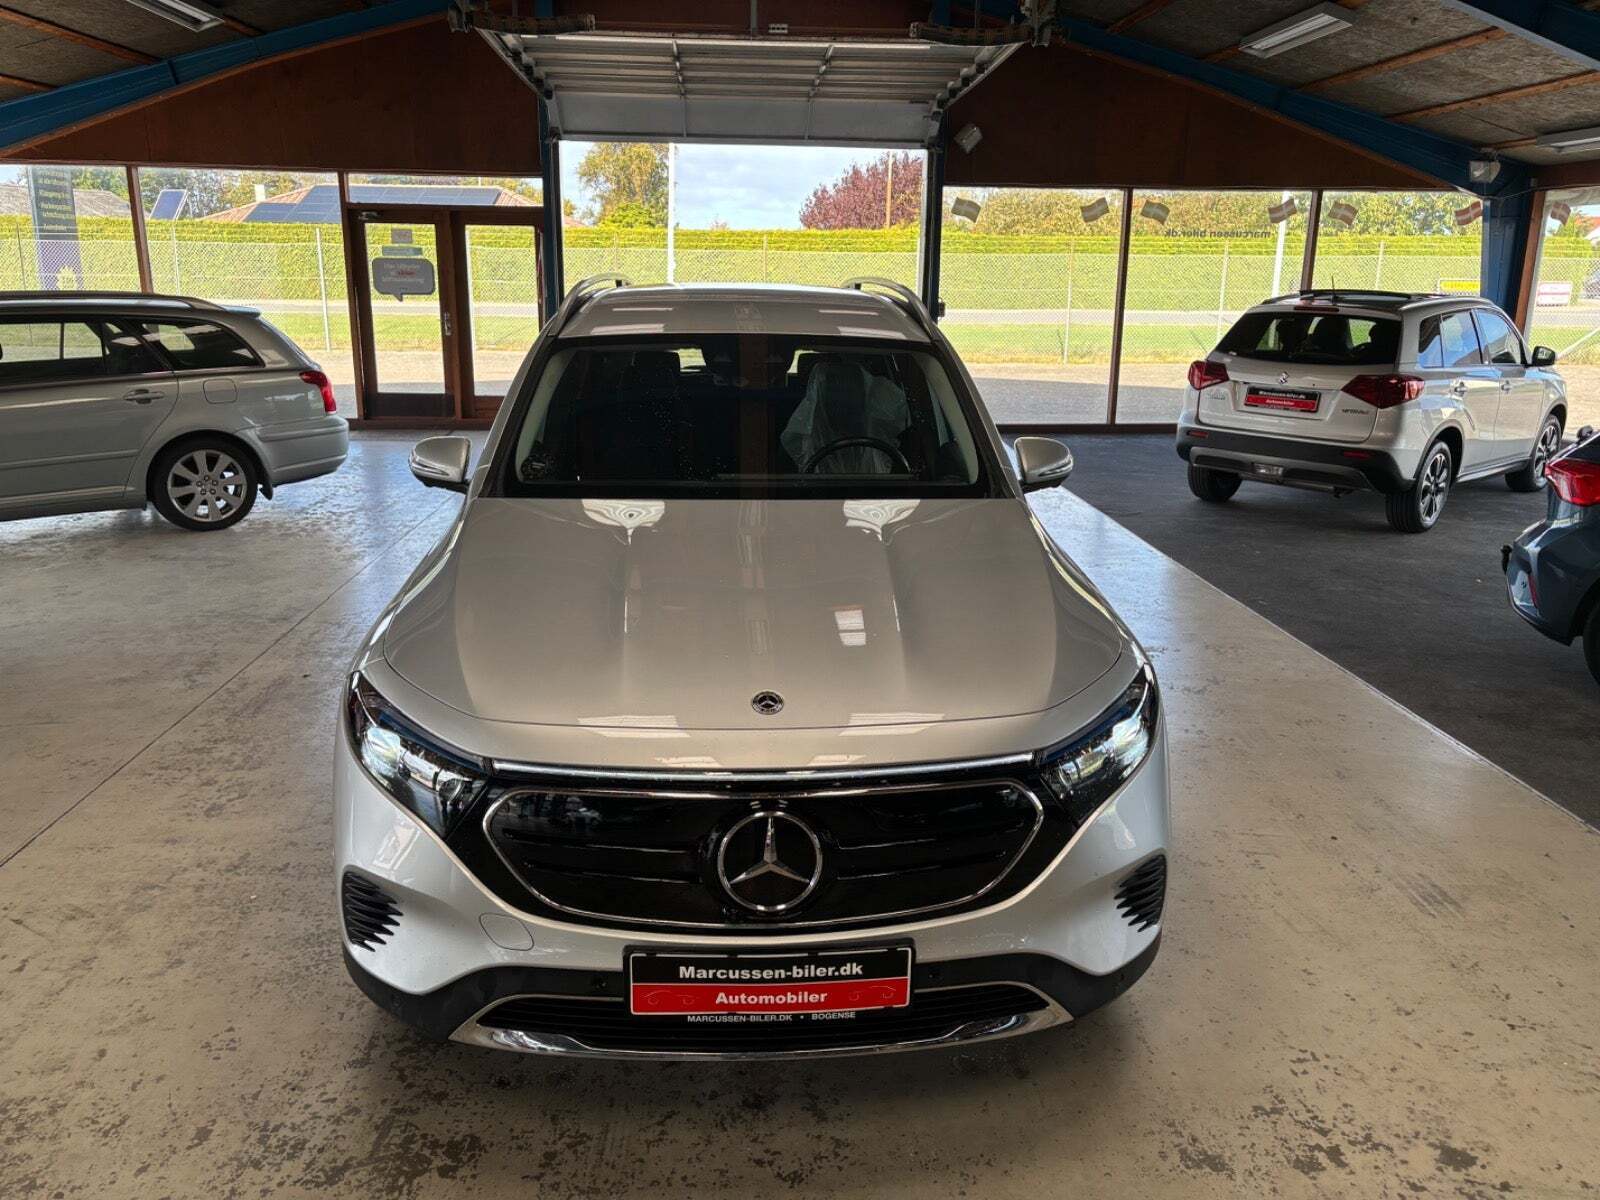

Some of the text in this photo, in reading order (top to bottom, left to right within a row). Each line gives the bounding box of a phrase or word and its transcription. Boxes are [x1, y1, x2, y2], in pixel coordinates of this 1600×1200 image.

[679, 962, 863, 980] Marcussen-biler.dk
[715, 991, 828, 1006] Automobiler
[687, 1011, 856, 1023] MARCUSSEN-BILER.DK BOGENSE
